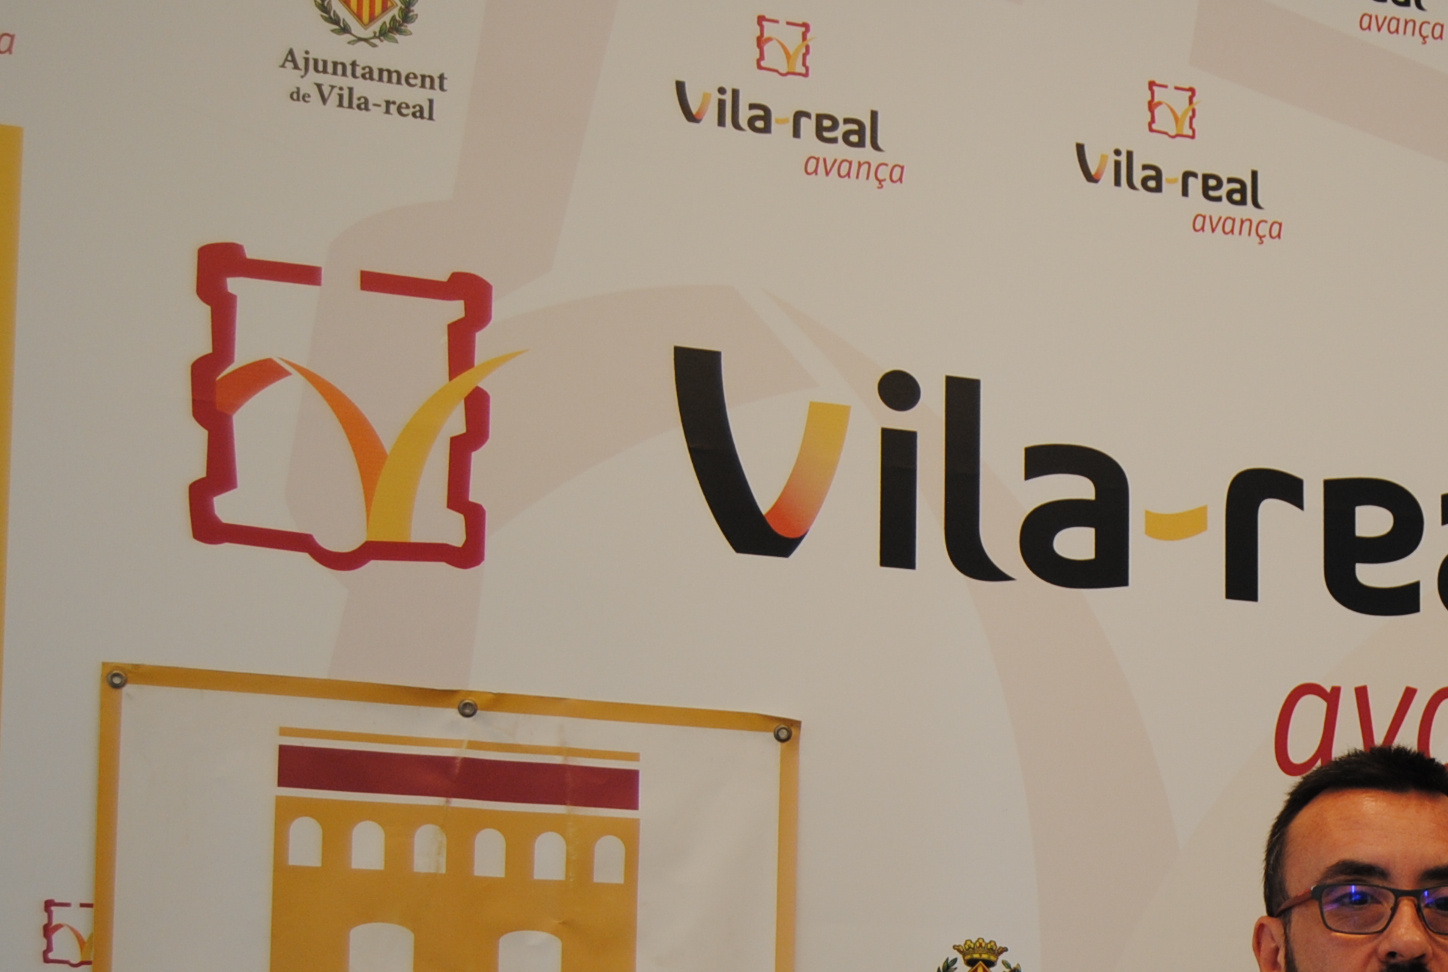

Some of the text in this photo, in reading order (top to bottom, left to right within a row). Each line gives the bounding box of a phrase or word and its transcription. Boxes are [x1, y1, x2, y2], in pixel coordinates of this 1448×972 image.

[1359, 12, 1445, 44] avança
[279, 47, 448, 92] Ajuntament
[290, 83, 436, 122] de Vila-real
[675, 80, 884, 152] Vila-real
[803, 154, 905, 189] avança
[1076, 142, 1264, 209] Vila-real
[1192, 213, 1282, 245] avança
